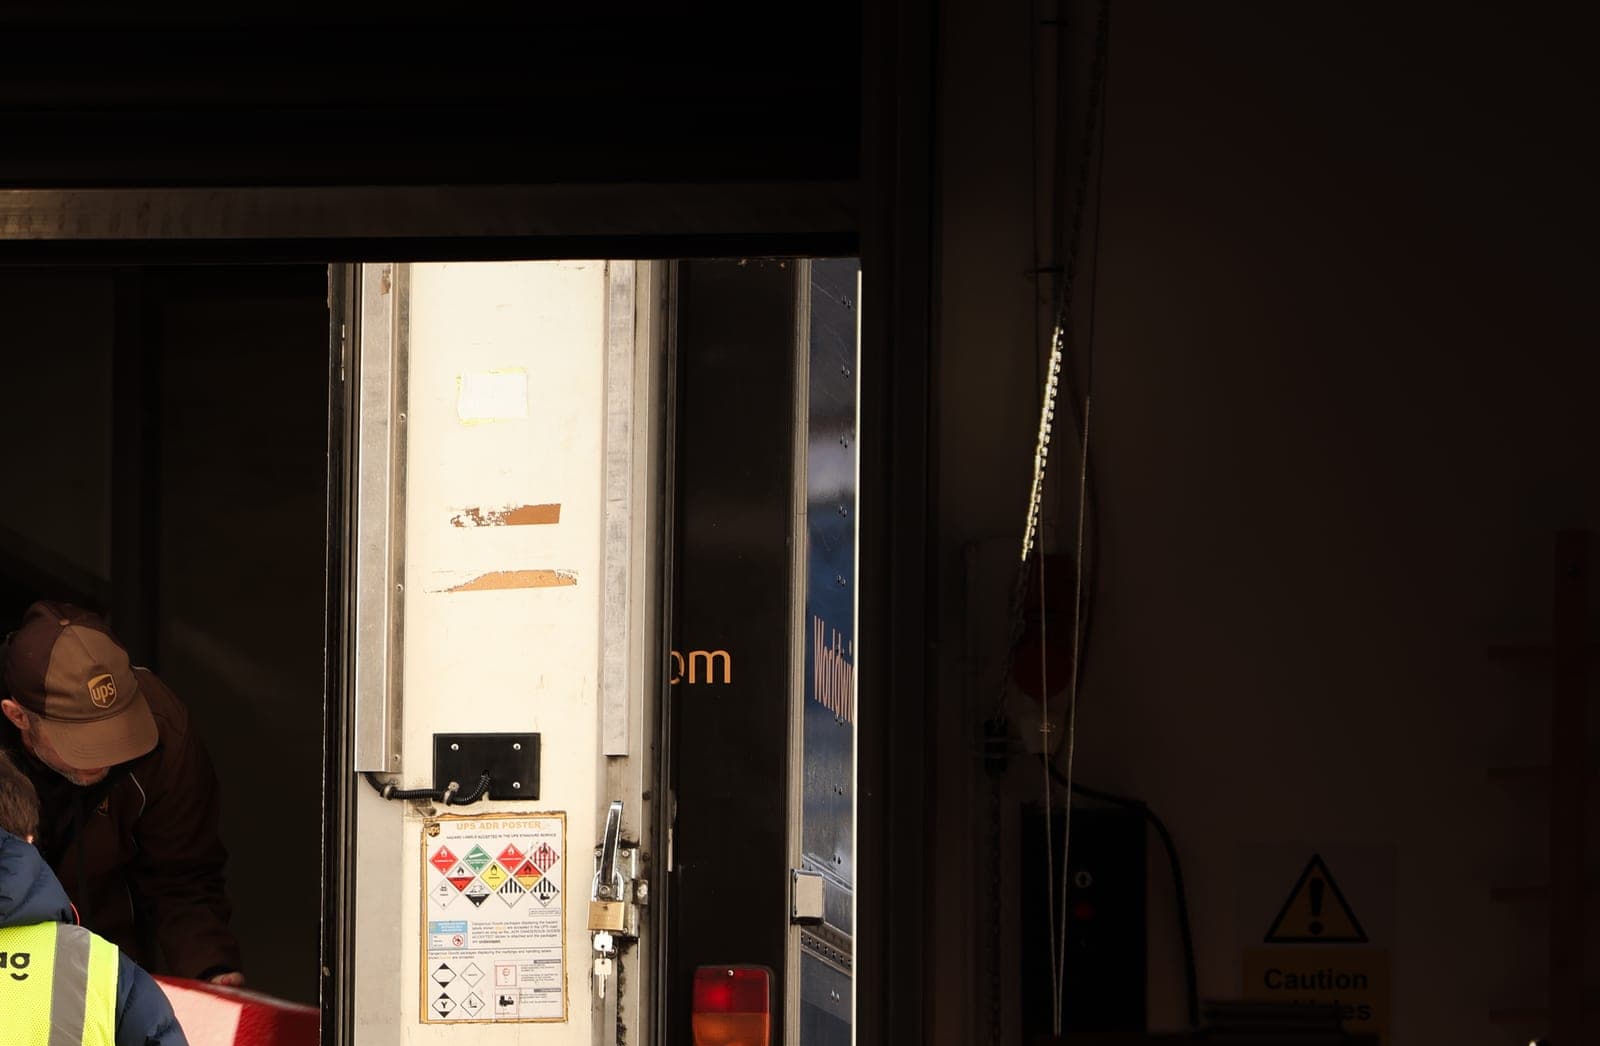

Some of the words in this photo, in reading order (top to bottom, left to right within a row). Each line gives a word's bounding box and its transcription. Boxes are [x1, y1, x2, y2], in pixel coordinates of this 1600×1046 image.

[92, 682, 115, 703] ups
[456, 822, 477, 831] UPS
[480, 821, 501, 830] ADR
[502, 820, 542, 830] POSTER
[1263, 967, 1369, 991] Caution
